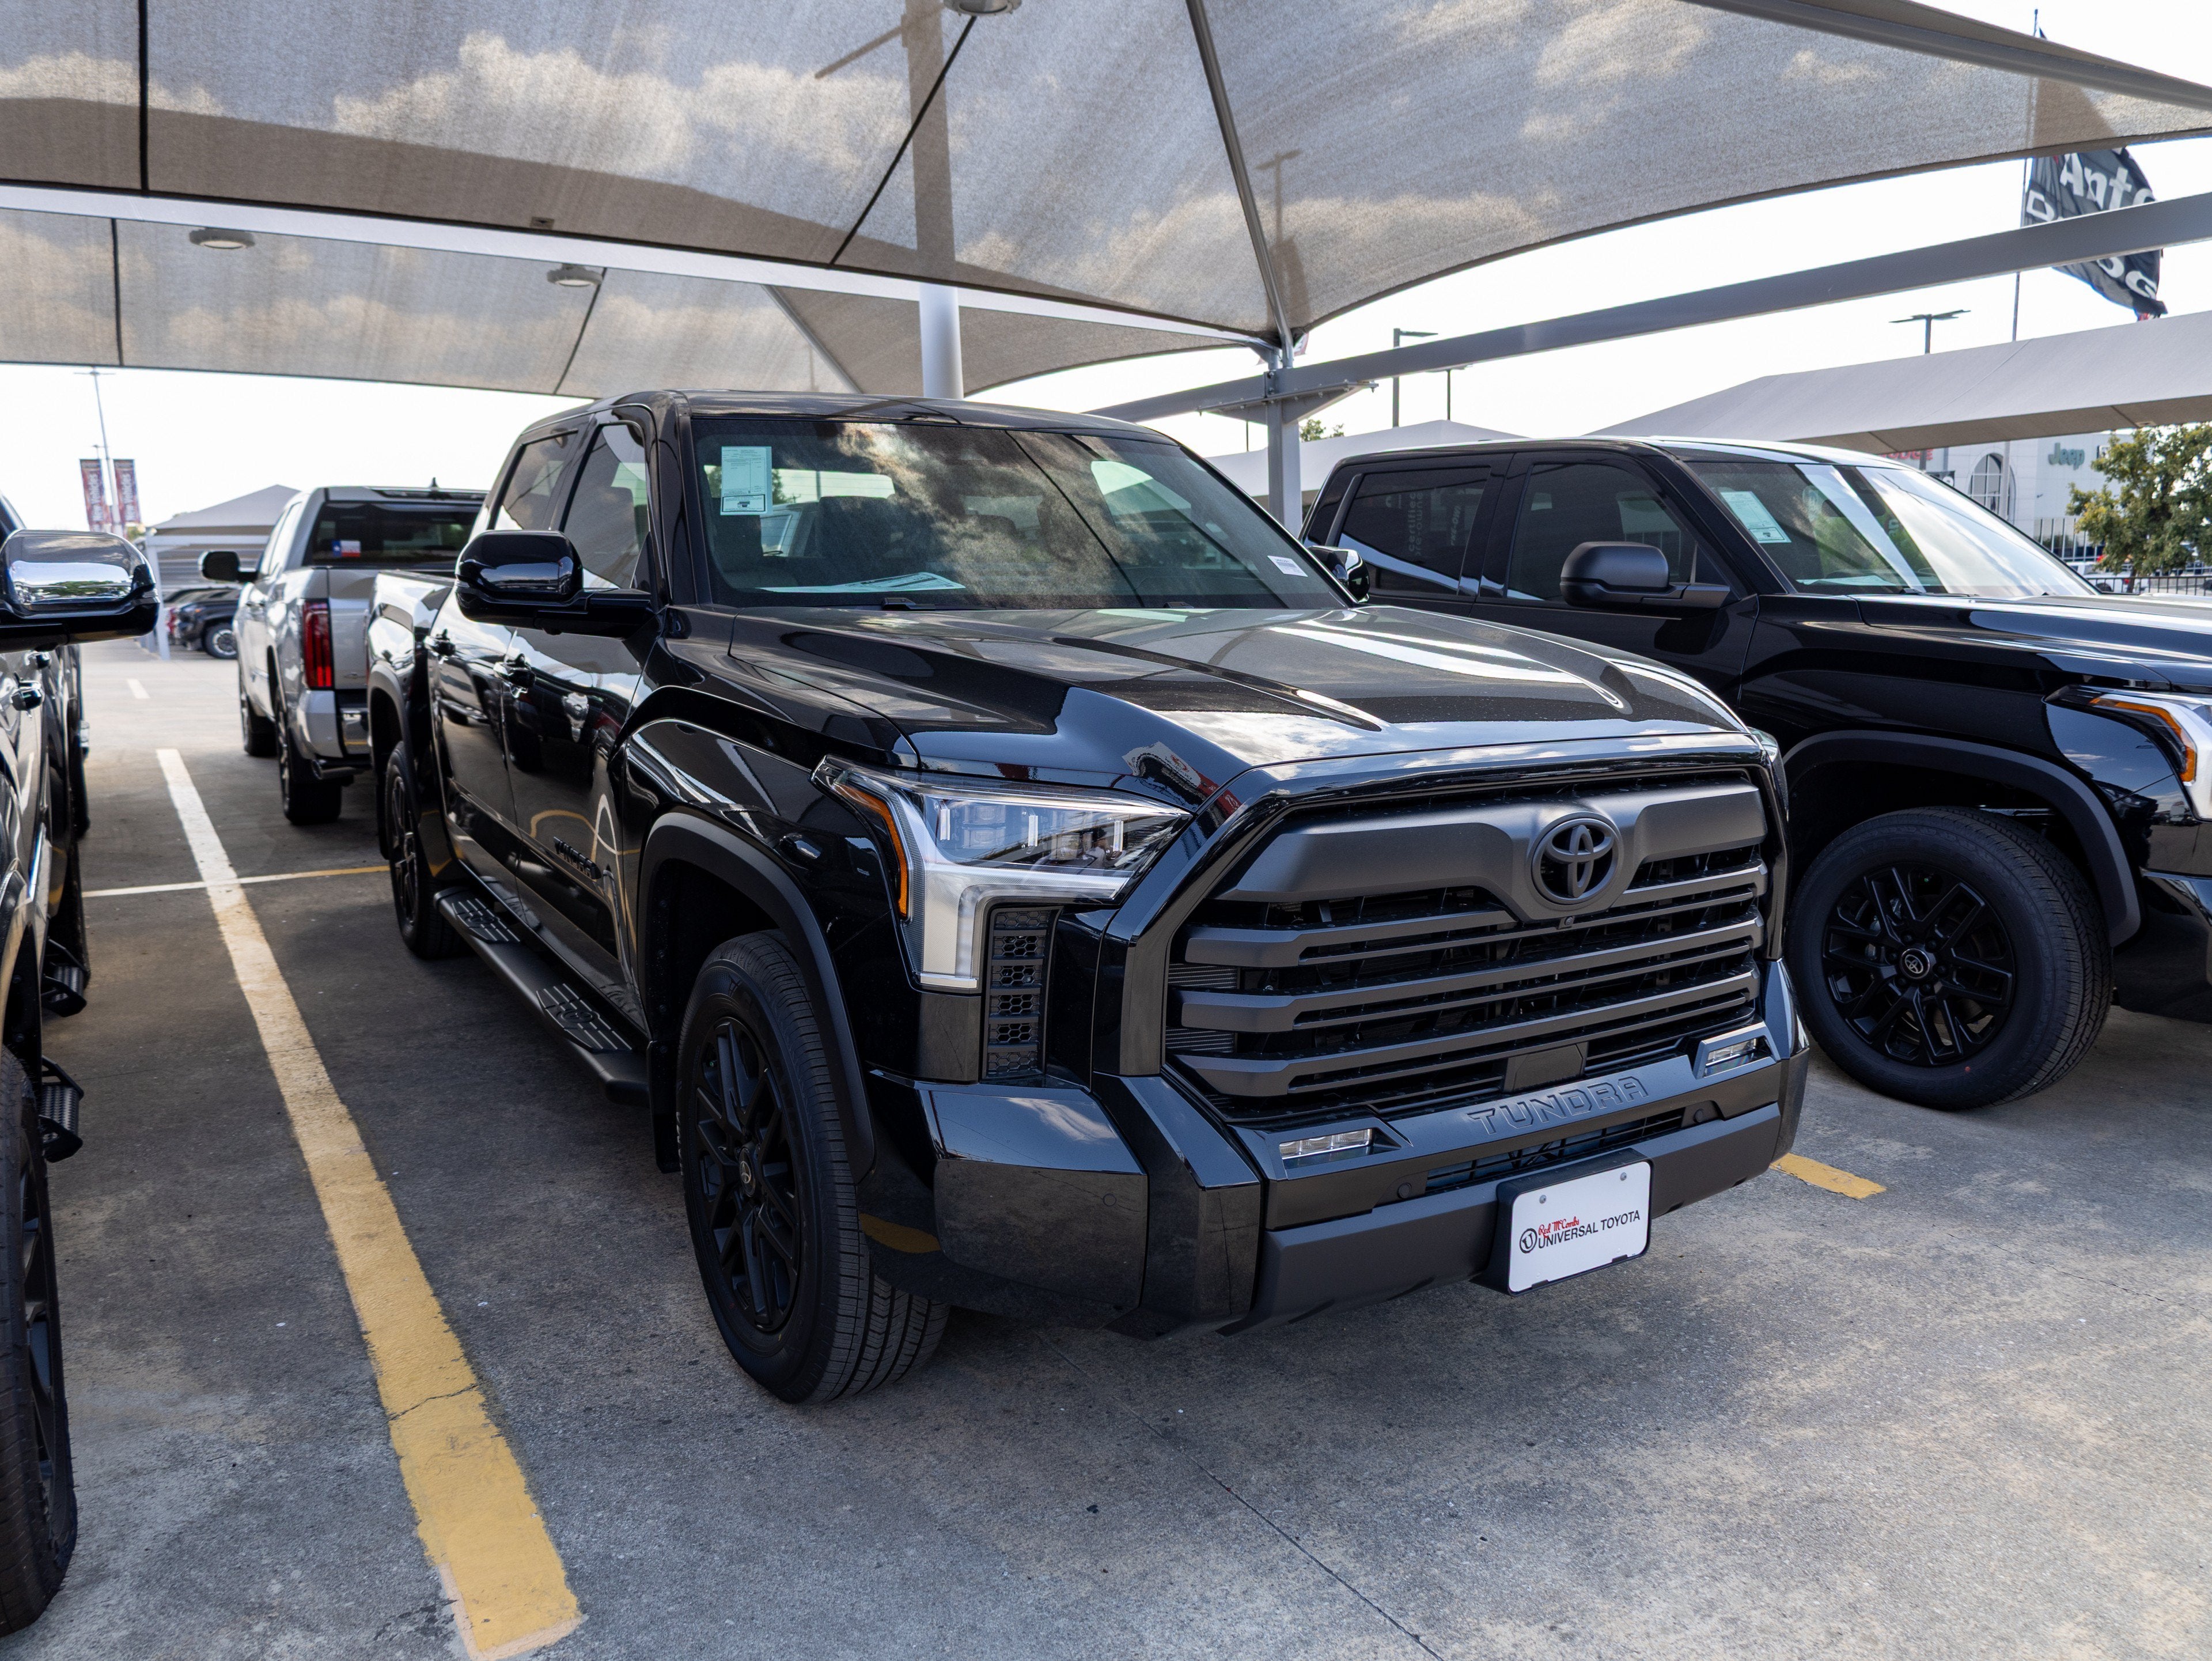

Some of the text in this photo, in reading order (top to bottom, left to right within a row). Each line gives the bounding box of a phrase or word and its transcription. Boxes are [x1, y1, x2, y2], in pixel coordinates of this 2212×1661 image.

[2048, 442, 2085, 470] Jeep
[1467, 1076, 1649, 1135] TUNDRA
[1538, 1224, 1551, 1238] Red
[1539, 1210, 1640, 1249] UNIVERSAL TOYOTA
